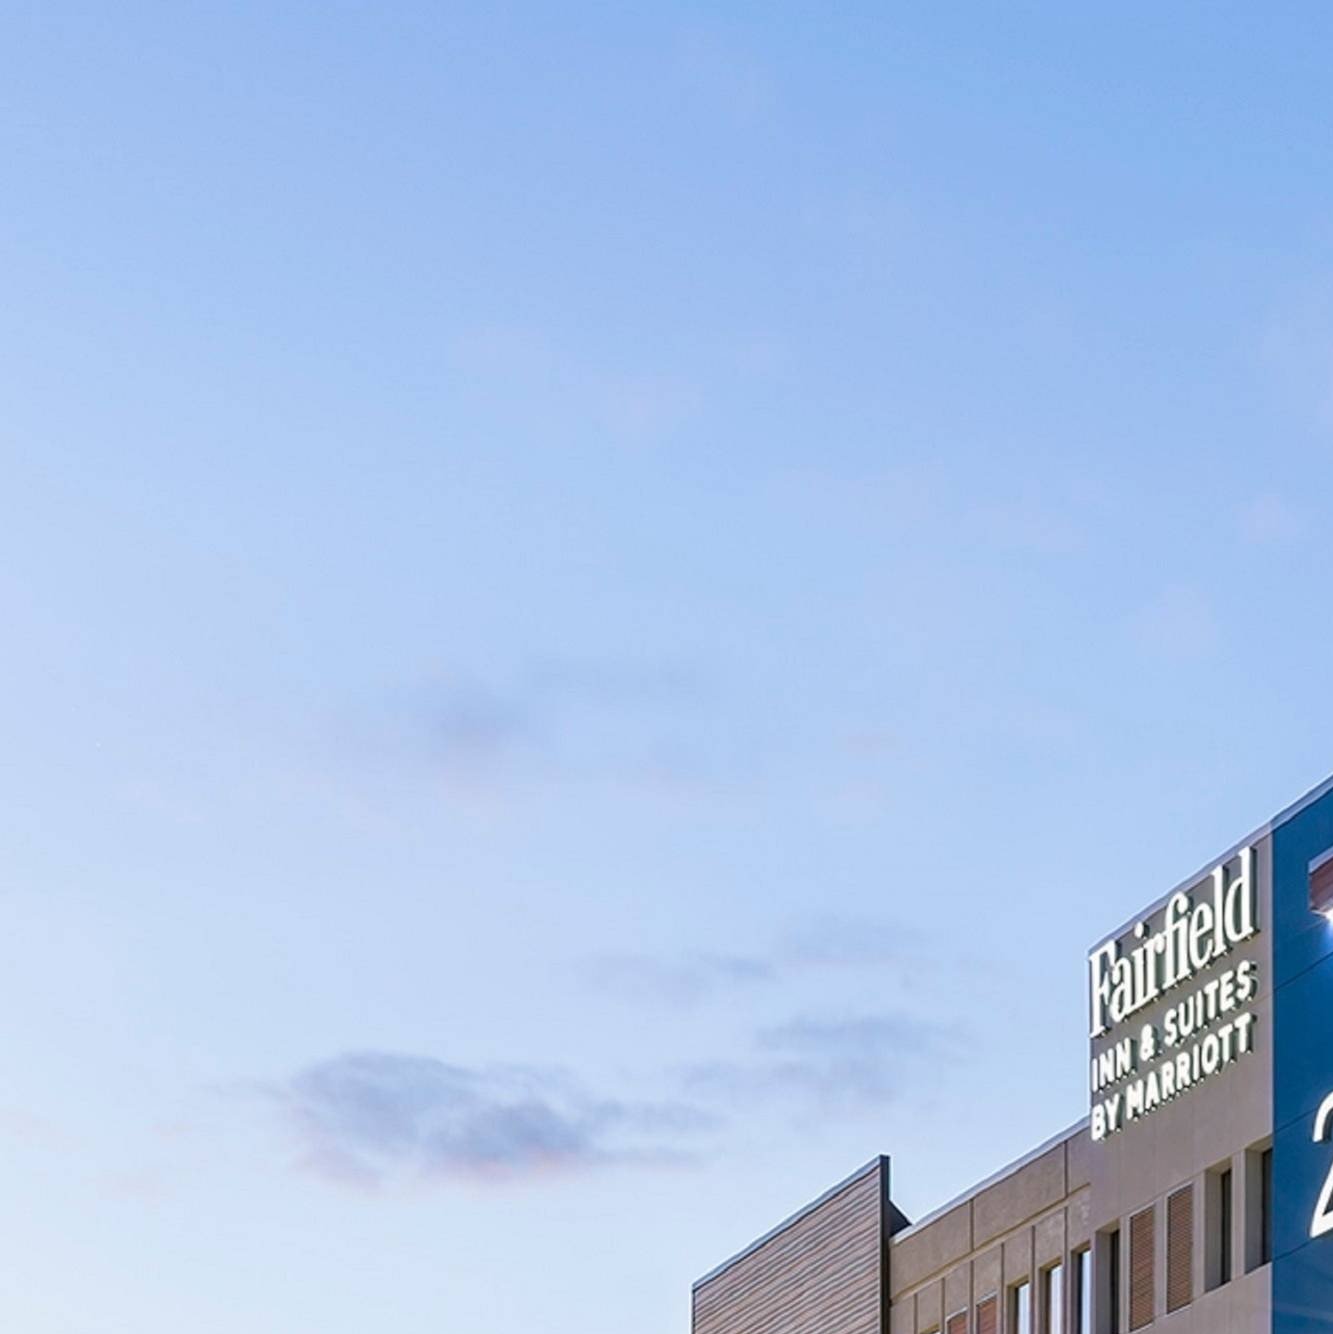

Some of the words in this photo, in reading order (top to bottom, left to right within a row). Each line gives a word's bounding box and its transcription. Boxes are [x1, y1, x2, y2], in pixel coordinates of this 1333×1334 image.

[1089, 847, 1254, 1038] Fairfield
[1091, 1093, 1120, 1141] BY
[1126, 1012, 1251, 1120] MARRIOTT
[1092, 1038, 1131, 1092] INN
[1140, 1024, 1156, 1062] &
[1164, 960, 1252, 1047] SUITES
